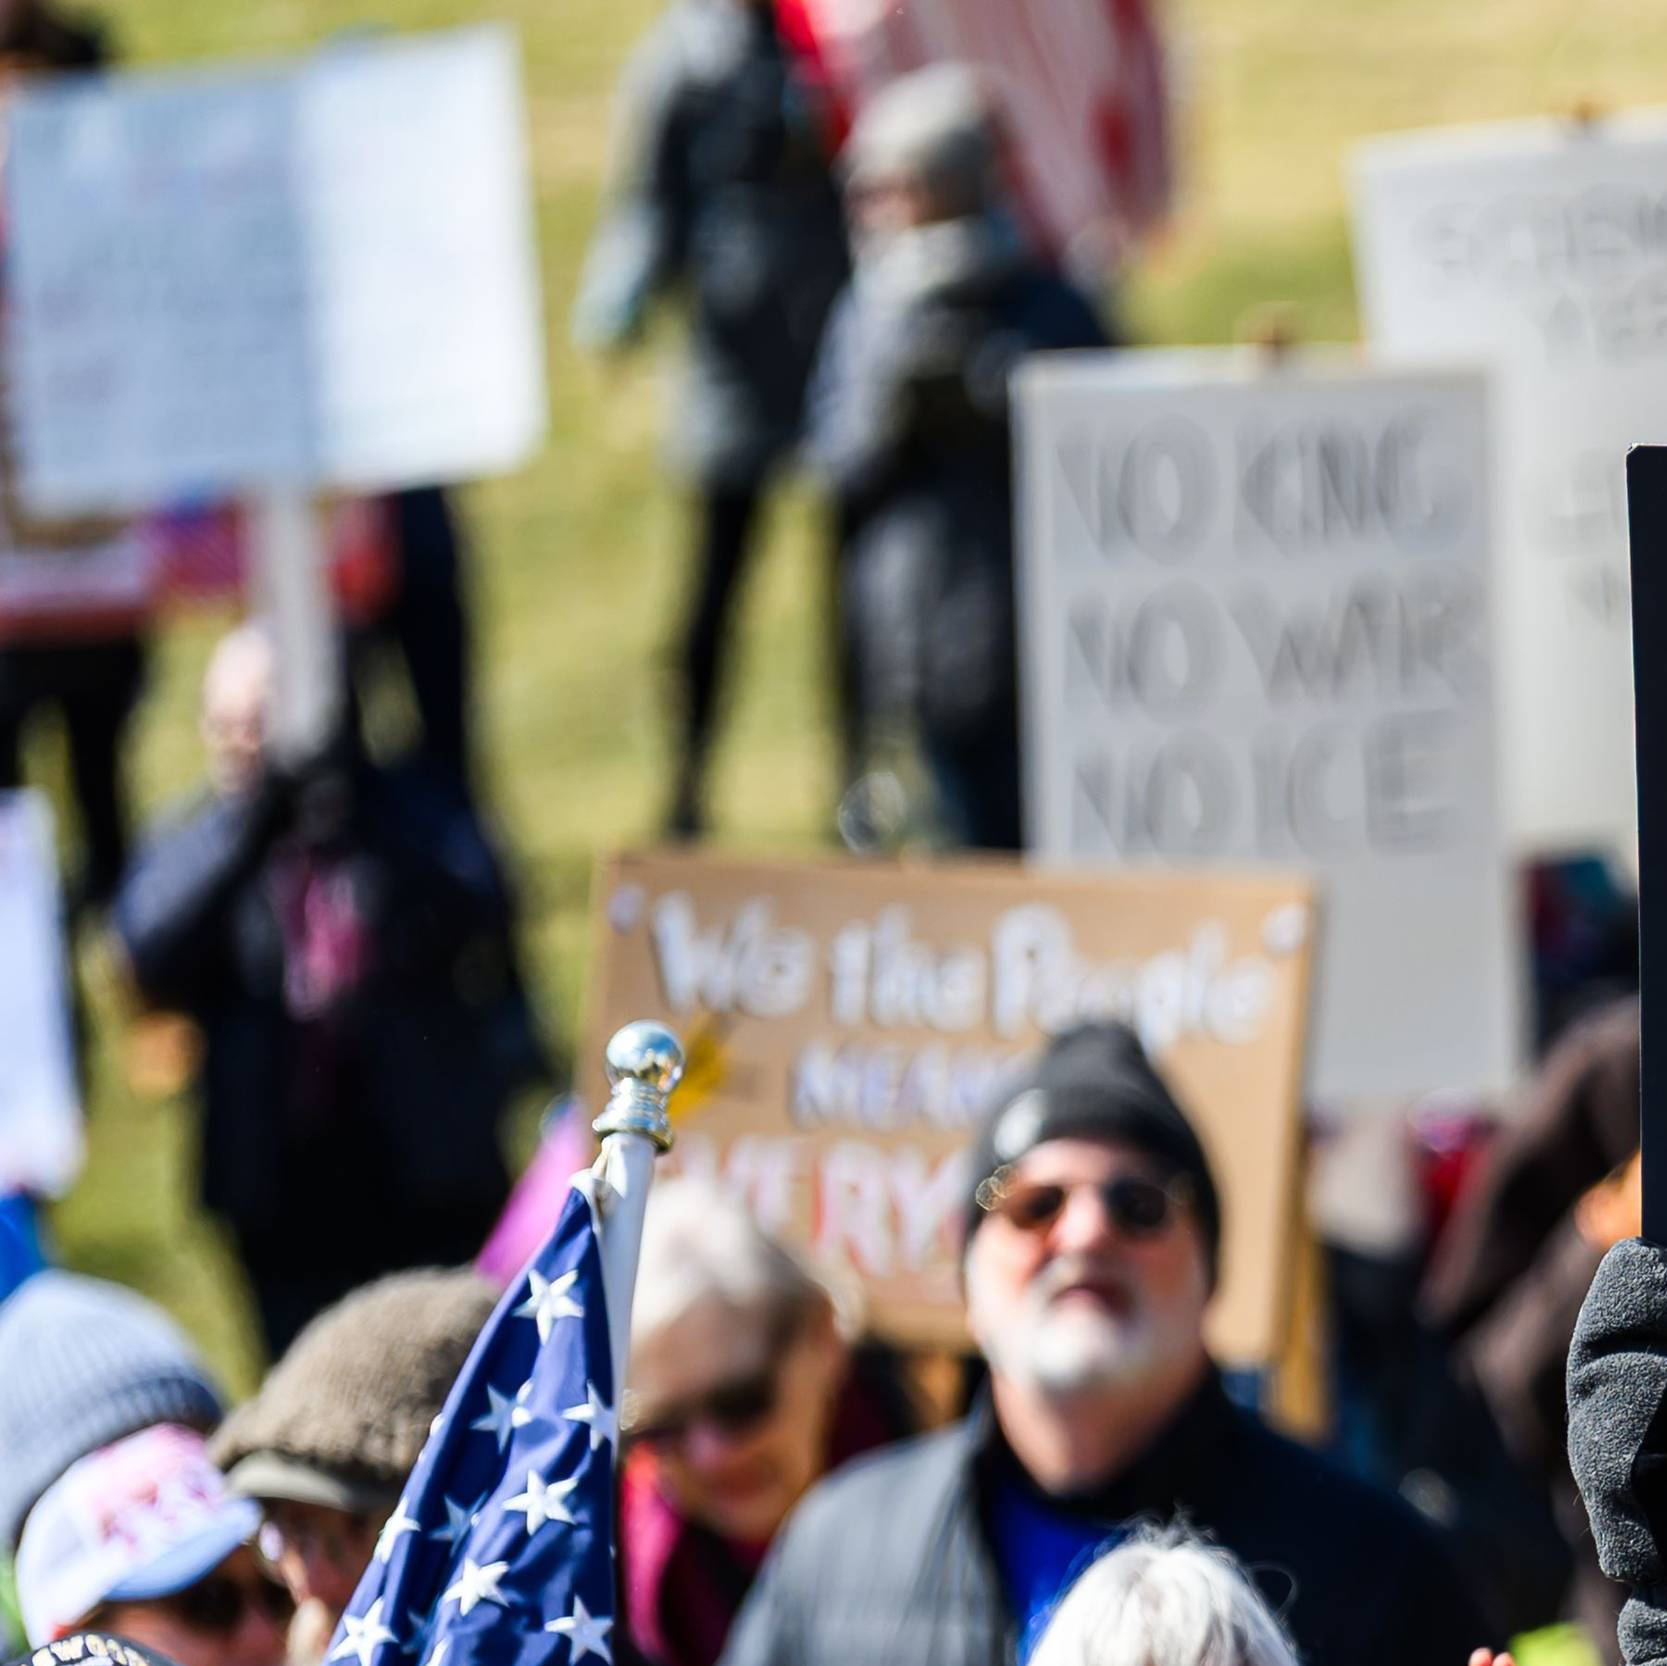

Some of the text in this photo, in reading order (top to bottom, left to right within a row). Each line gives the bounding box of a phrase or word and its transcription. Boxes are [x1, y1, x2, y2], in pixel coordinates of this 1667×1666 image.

[650, 888, 1282, 1066] We the People
